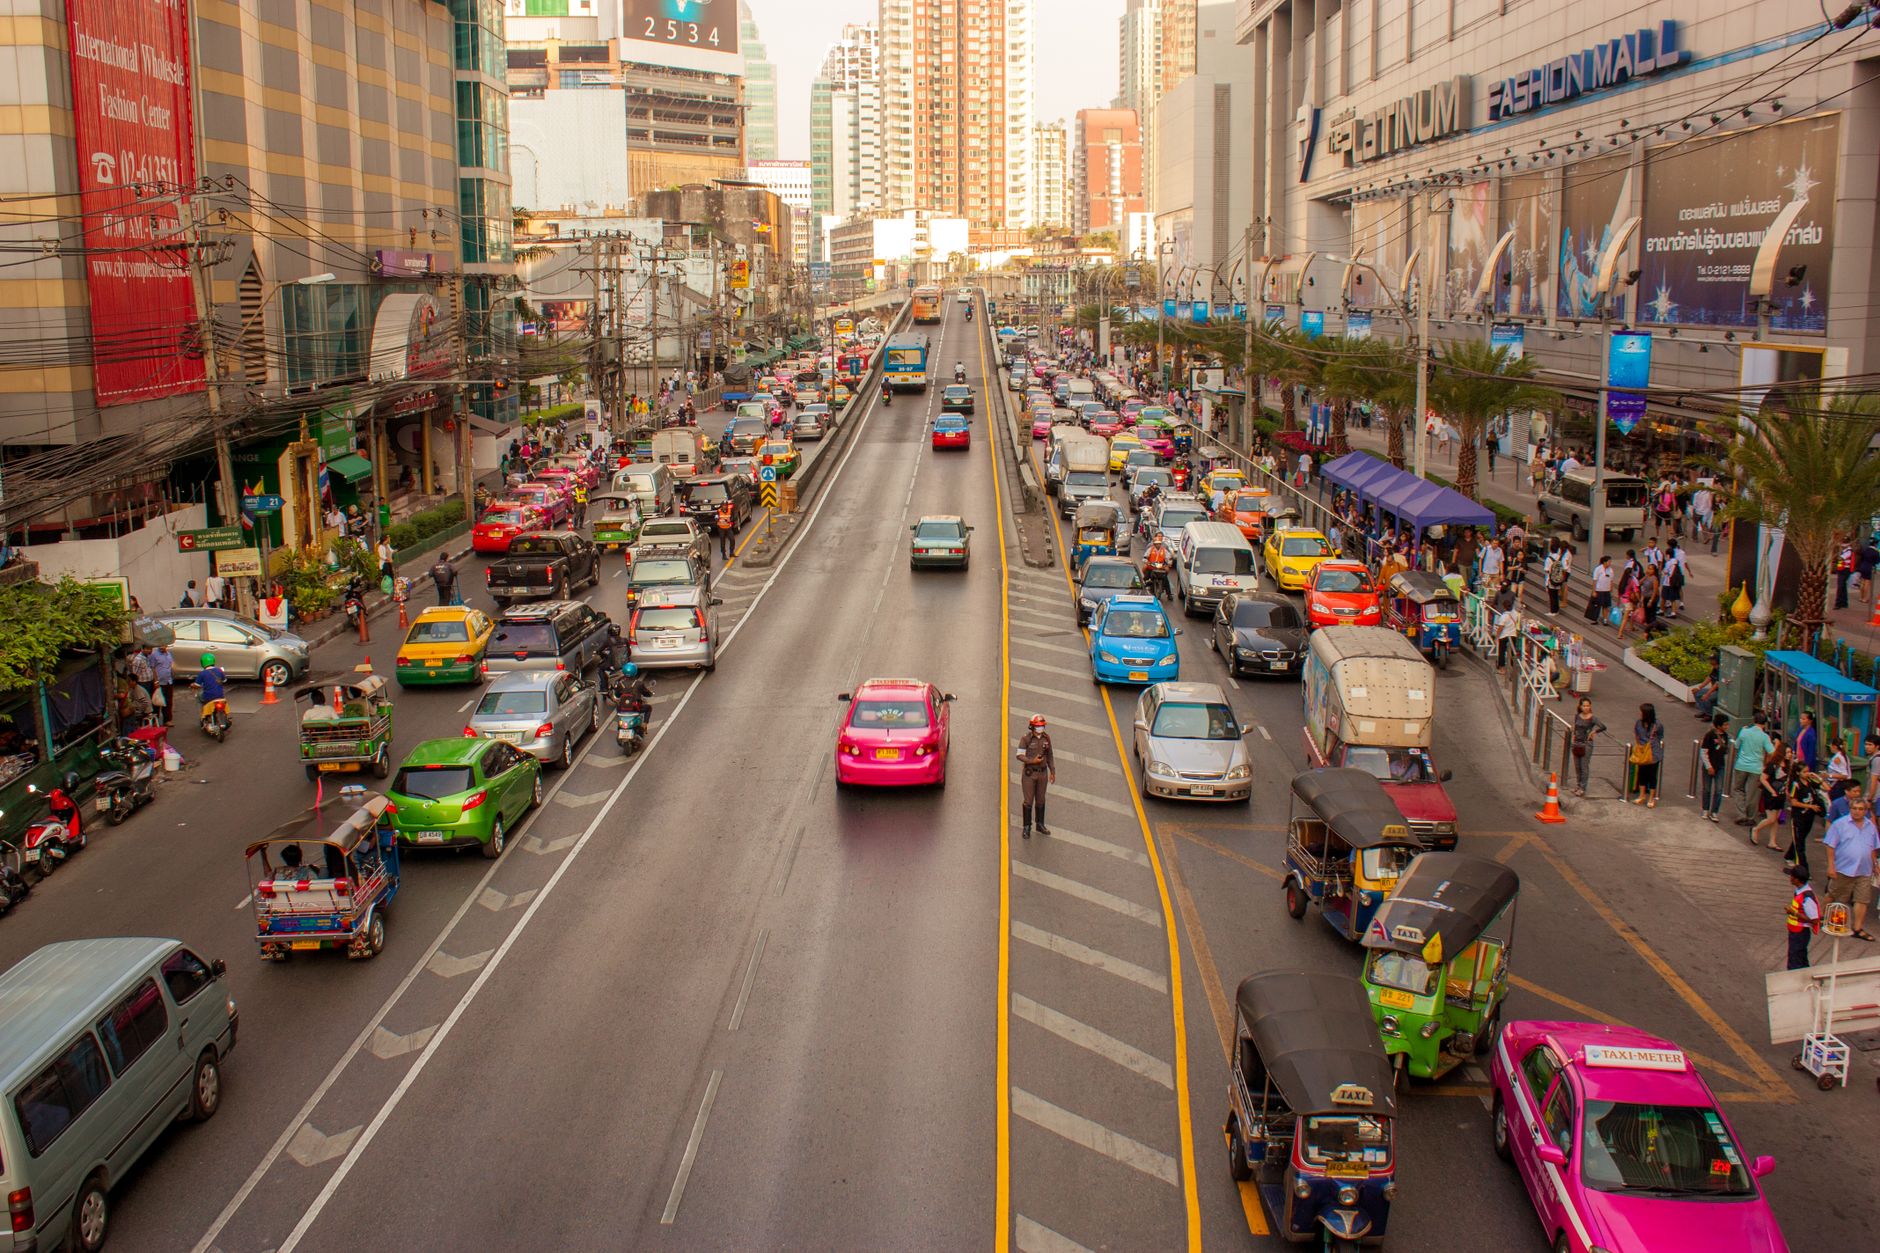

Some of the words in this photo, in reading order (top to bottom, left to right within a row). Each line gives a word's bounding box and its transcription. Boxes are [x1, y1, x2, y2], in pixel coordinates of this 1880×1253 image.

[73, 20, 139, 73] International
[141, 43, 184, 87] Wholesale
[1488, 49, 1591, 121] FASHION
[1592, 19, 1691, 89] MALL
[98, 82, 139, 124] Fashion
[141, 94, 171, 130] Center
[269, 497, 279, 506] 21
[1211, 577, 1239, 587] FedEx
[1396, 928, 1418, 940] TAXI
[1601, 1049, 1683, 1064] TAXI-METER
[1340, 1089, 1367, 1101] TAXI
